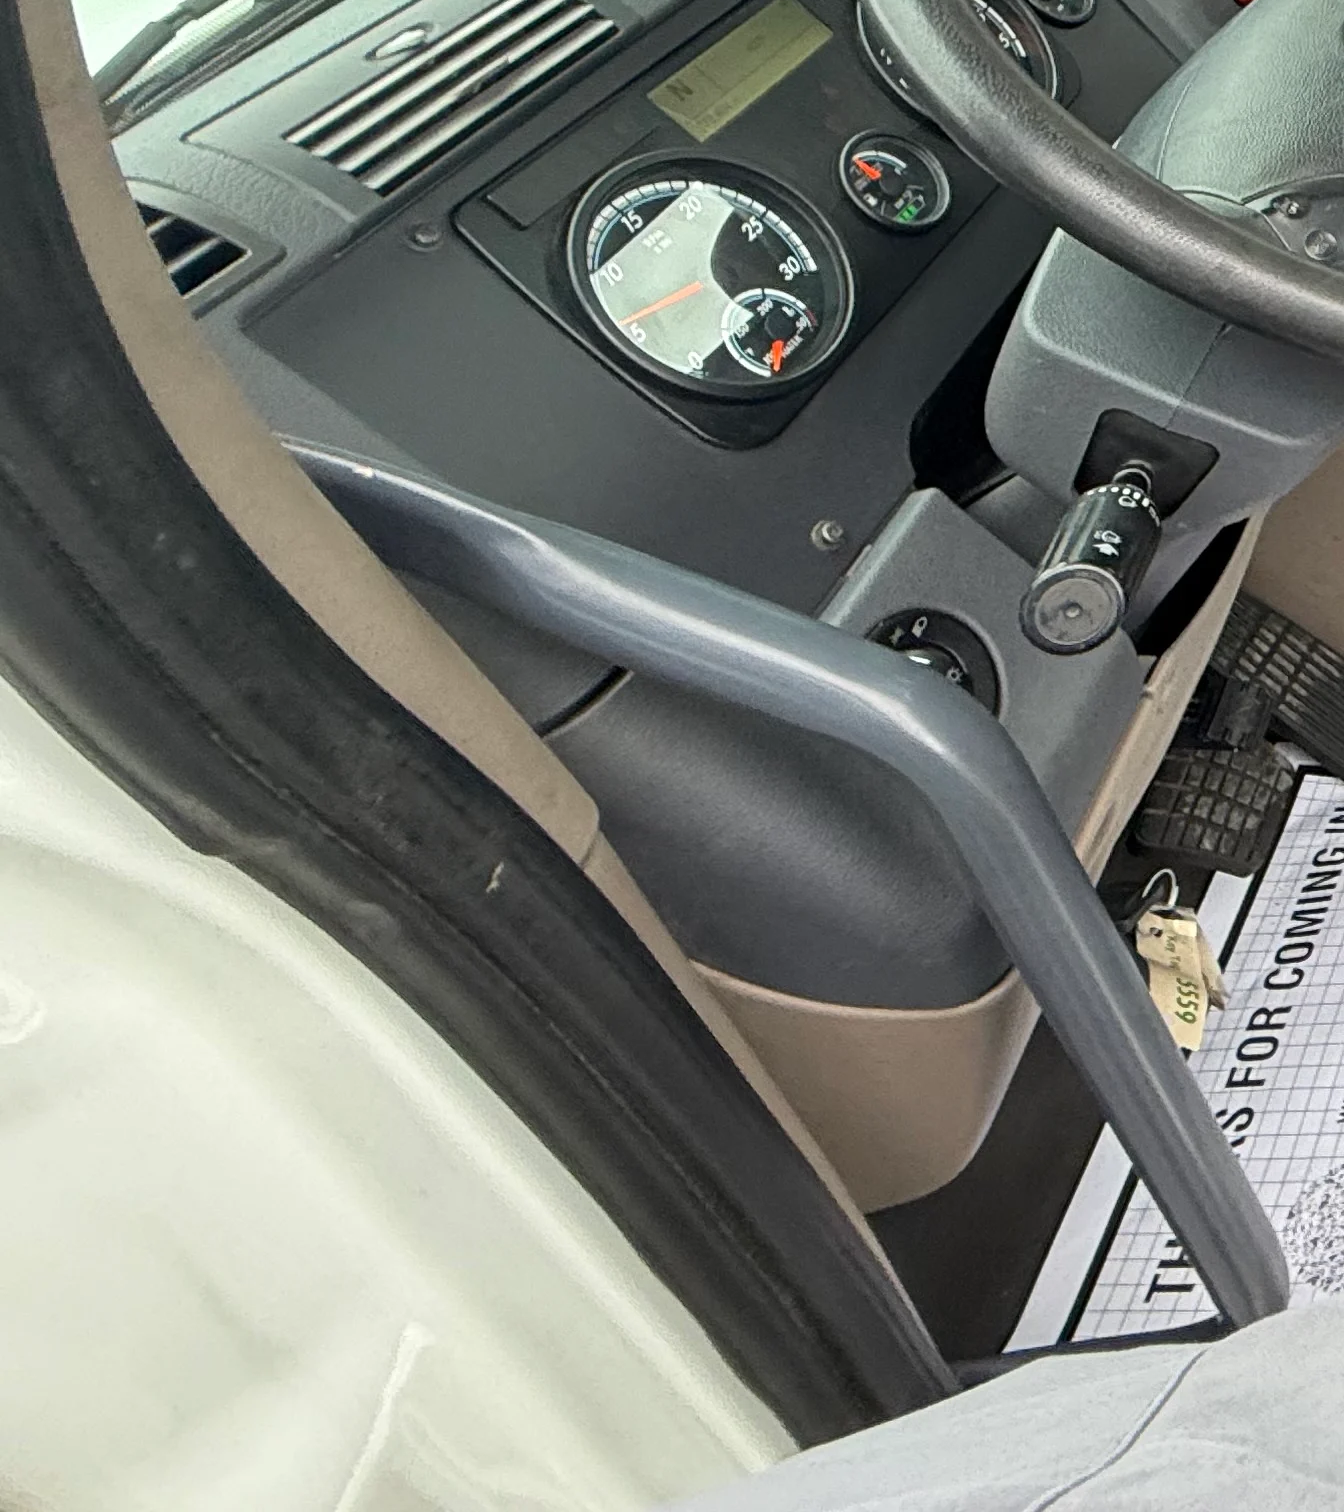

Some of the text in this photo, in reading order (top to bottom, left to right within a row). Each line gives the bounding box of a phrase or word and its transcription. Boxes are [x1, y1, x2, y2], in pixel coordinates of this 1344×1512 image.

[679, 195, 702, 220] 20
[620, 209, 643, 233] 15
[741, 215, 763, 242] 25
[600, 262, 624, 286] 10
[779, 255, 800, 281] 30
[631, 322, 647, 343] 5
[688, 351, 704, 371] 0
[1175, 977, 1200, 1024] 5559
[1226, 1005, 1293, 1088] FOR
